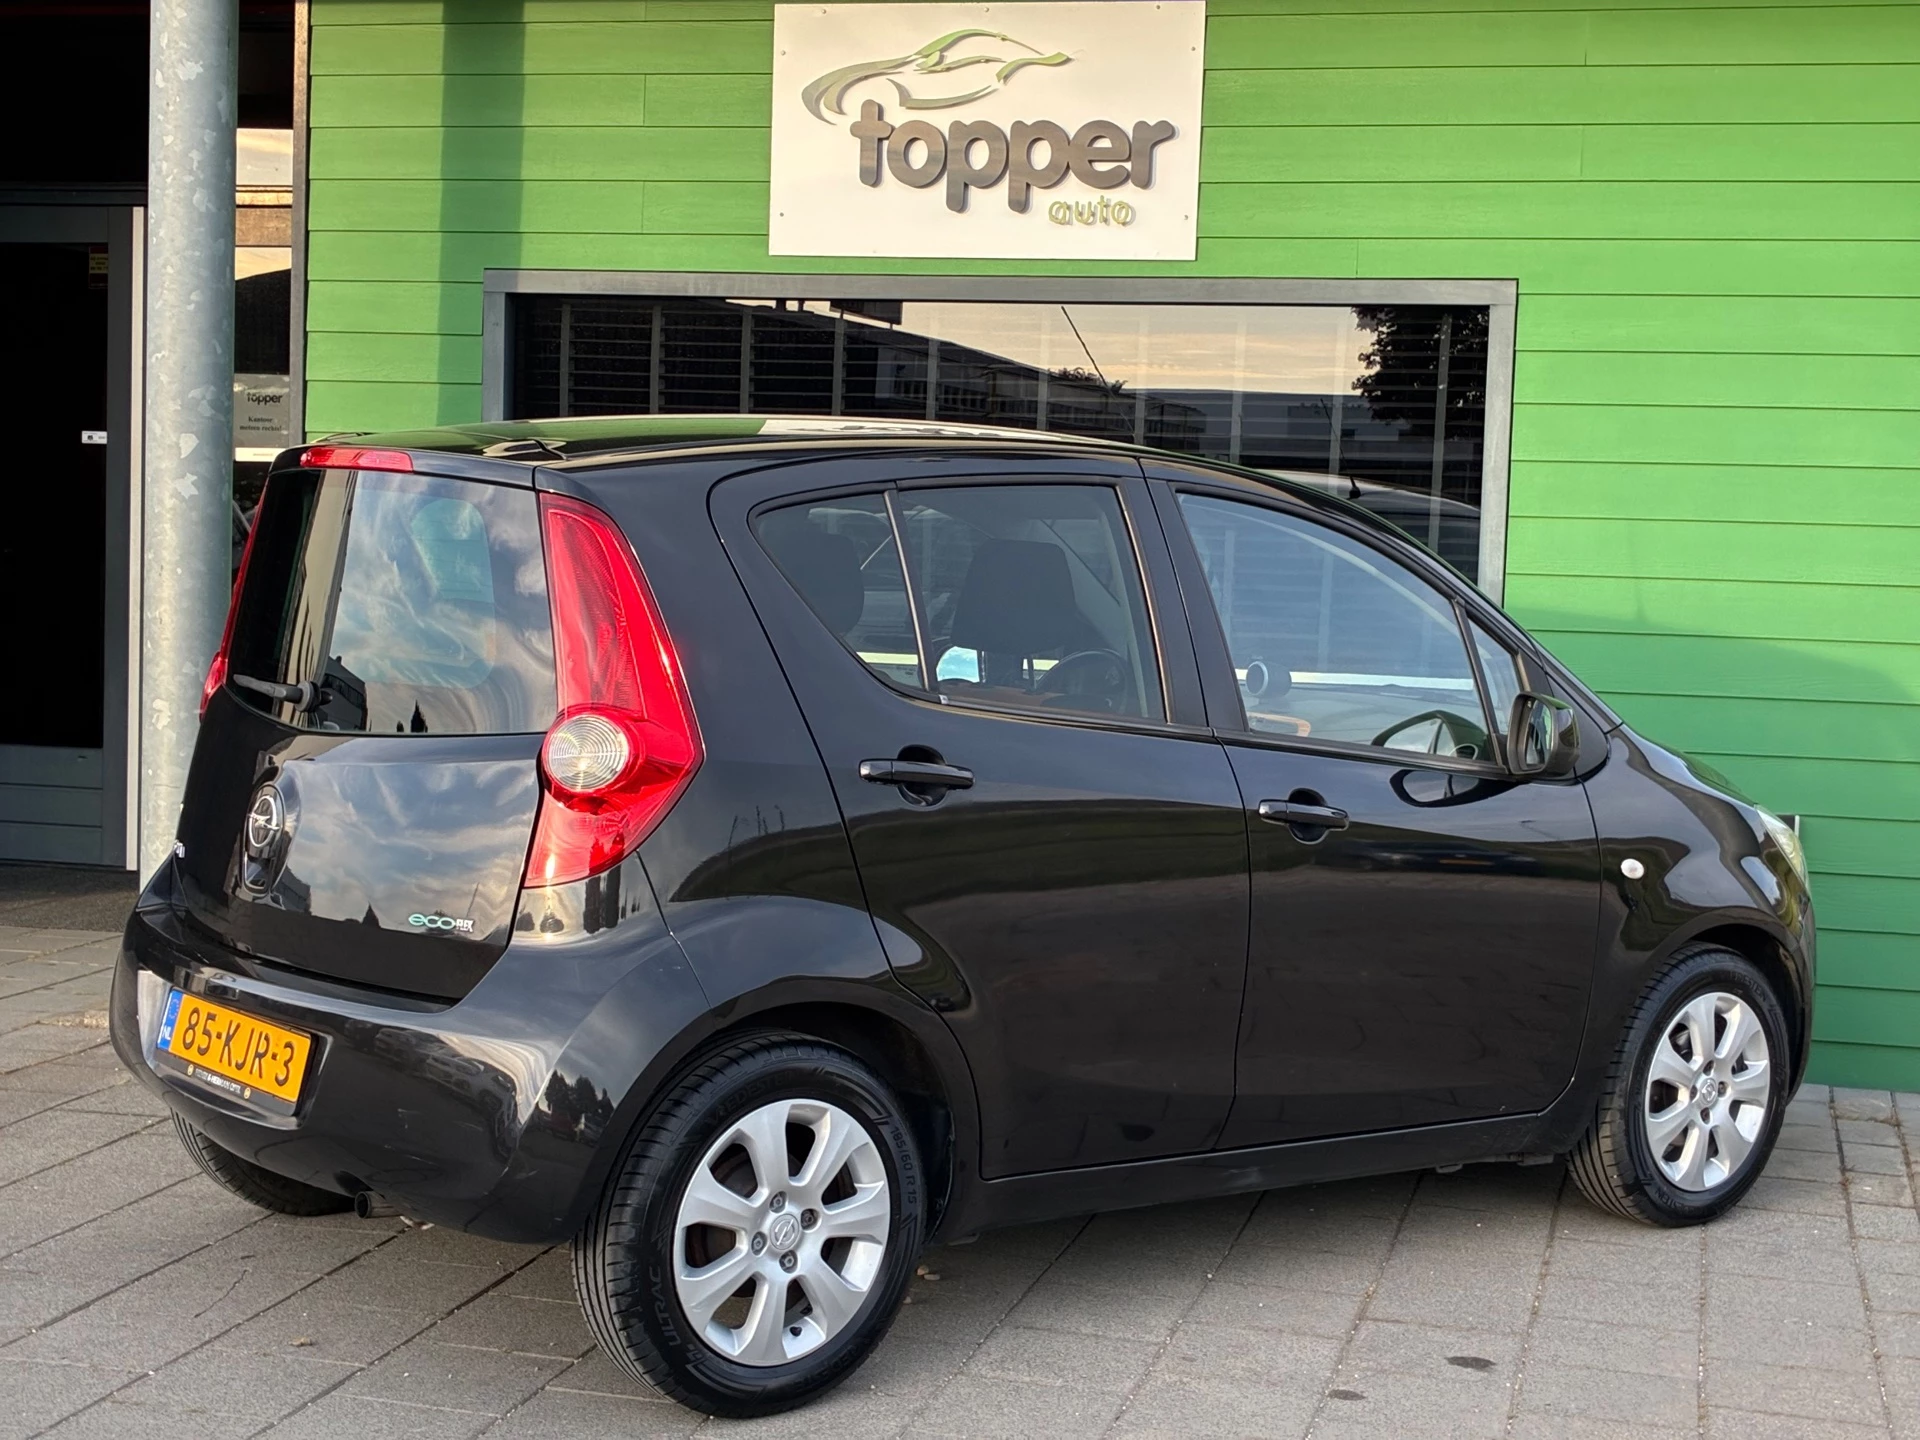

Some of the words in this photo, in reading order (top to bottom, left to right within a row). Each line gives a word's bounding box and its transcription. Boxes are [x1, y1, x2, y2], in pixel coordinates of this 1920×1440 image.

[850, 99, 1176, 213] topper
[1048, 196, 1133, 226] auto
[162, 1025, 171, 1041] NL
[182, 1007, 296, 1088] 85-KJR-3
[648, 1265, 682, 1347] ULTRAC
